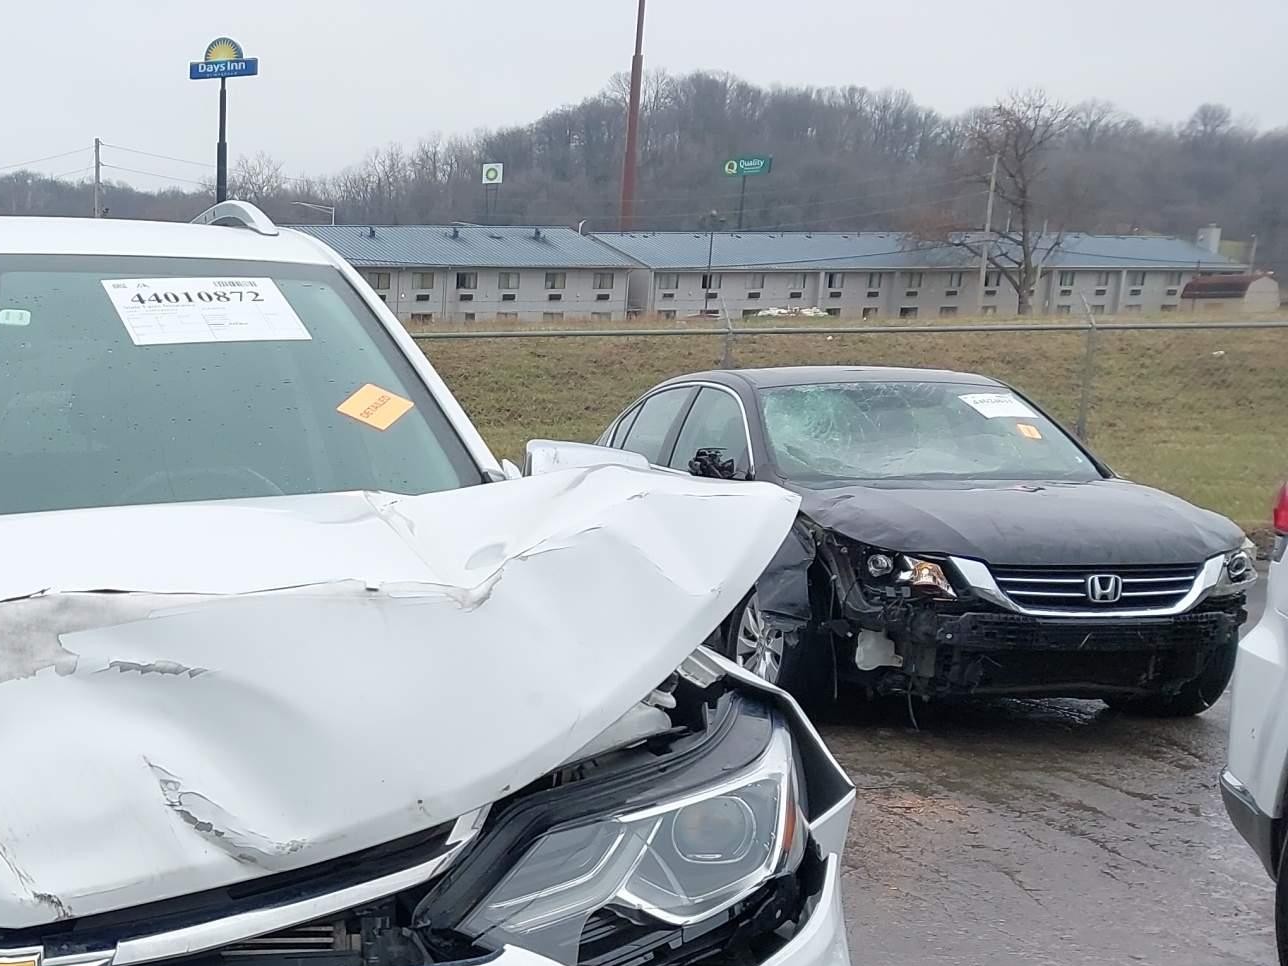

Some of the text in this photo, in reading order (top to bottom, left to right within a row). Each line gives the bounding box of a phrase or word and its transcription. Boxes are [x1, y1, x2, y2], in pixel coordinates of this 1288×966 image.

[198, 61, 245, 73] Days Inn
[739, 158, 765, 169] Quality
[130, 290, 265, 305] 44010872
